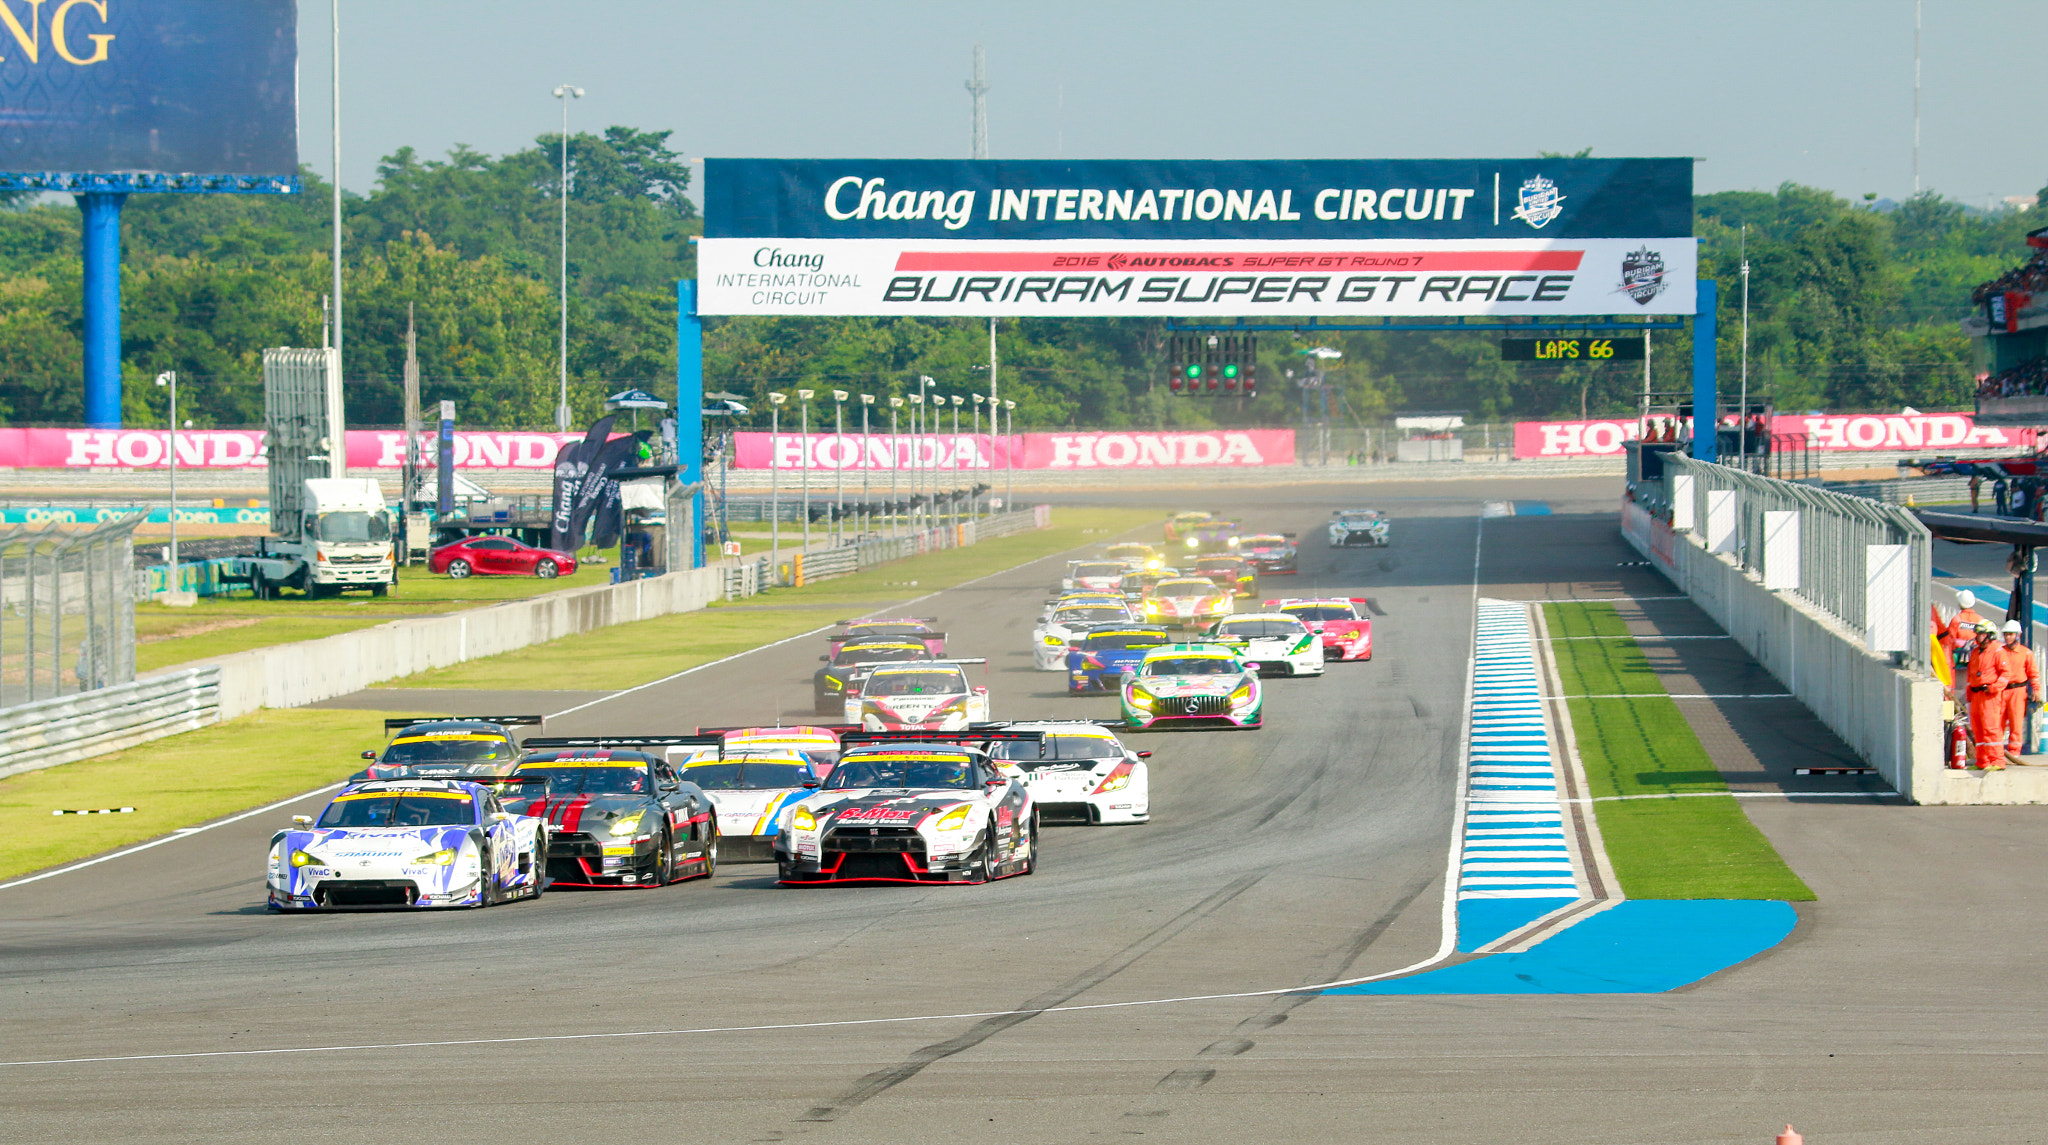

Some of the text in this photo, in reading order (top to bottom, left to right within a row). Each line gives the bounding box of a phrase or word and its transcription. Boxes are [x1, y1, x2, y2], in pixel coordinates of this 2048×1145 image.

[825, 176, 1475, 230] Chang INTERNATIONAL CIRCUIT
[753, 247, 824, 273] Chang
[1053, 256, 1101, 266] 2016
[1131, 257, 1235, 267] AUTOBACS
[1243, 256, 1314, 266] SUPER
[1317, 257, 1349, 266] GT
[1412, 257, 1424, 266] 7
[716, 273, 862, 288] INTERNATIONAL
[882, 275, 1576, 303] BURIRAM SUPER GT RACE
[752, 291, 828, 305] CIRCUIT
[1535, 340, 1614, 359] LAPS 66
[769, 435, 990, 469] HONDA
[1050, 434, 1263, 466] HONDA
[483, 556, 512, 564] Medical
[834, 807, 919, 820] B-Max
[309, 868, 330, 876] VivaC
[401, 867, 428, 876] VivaC
